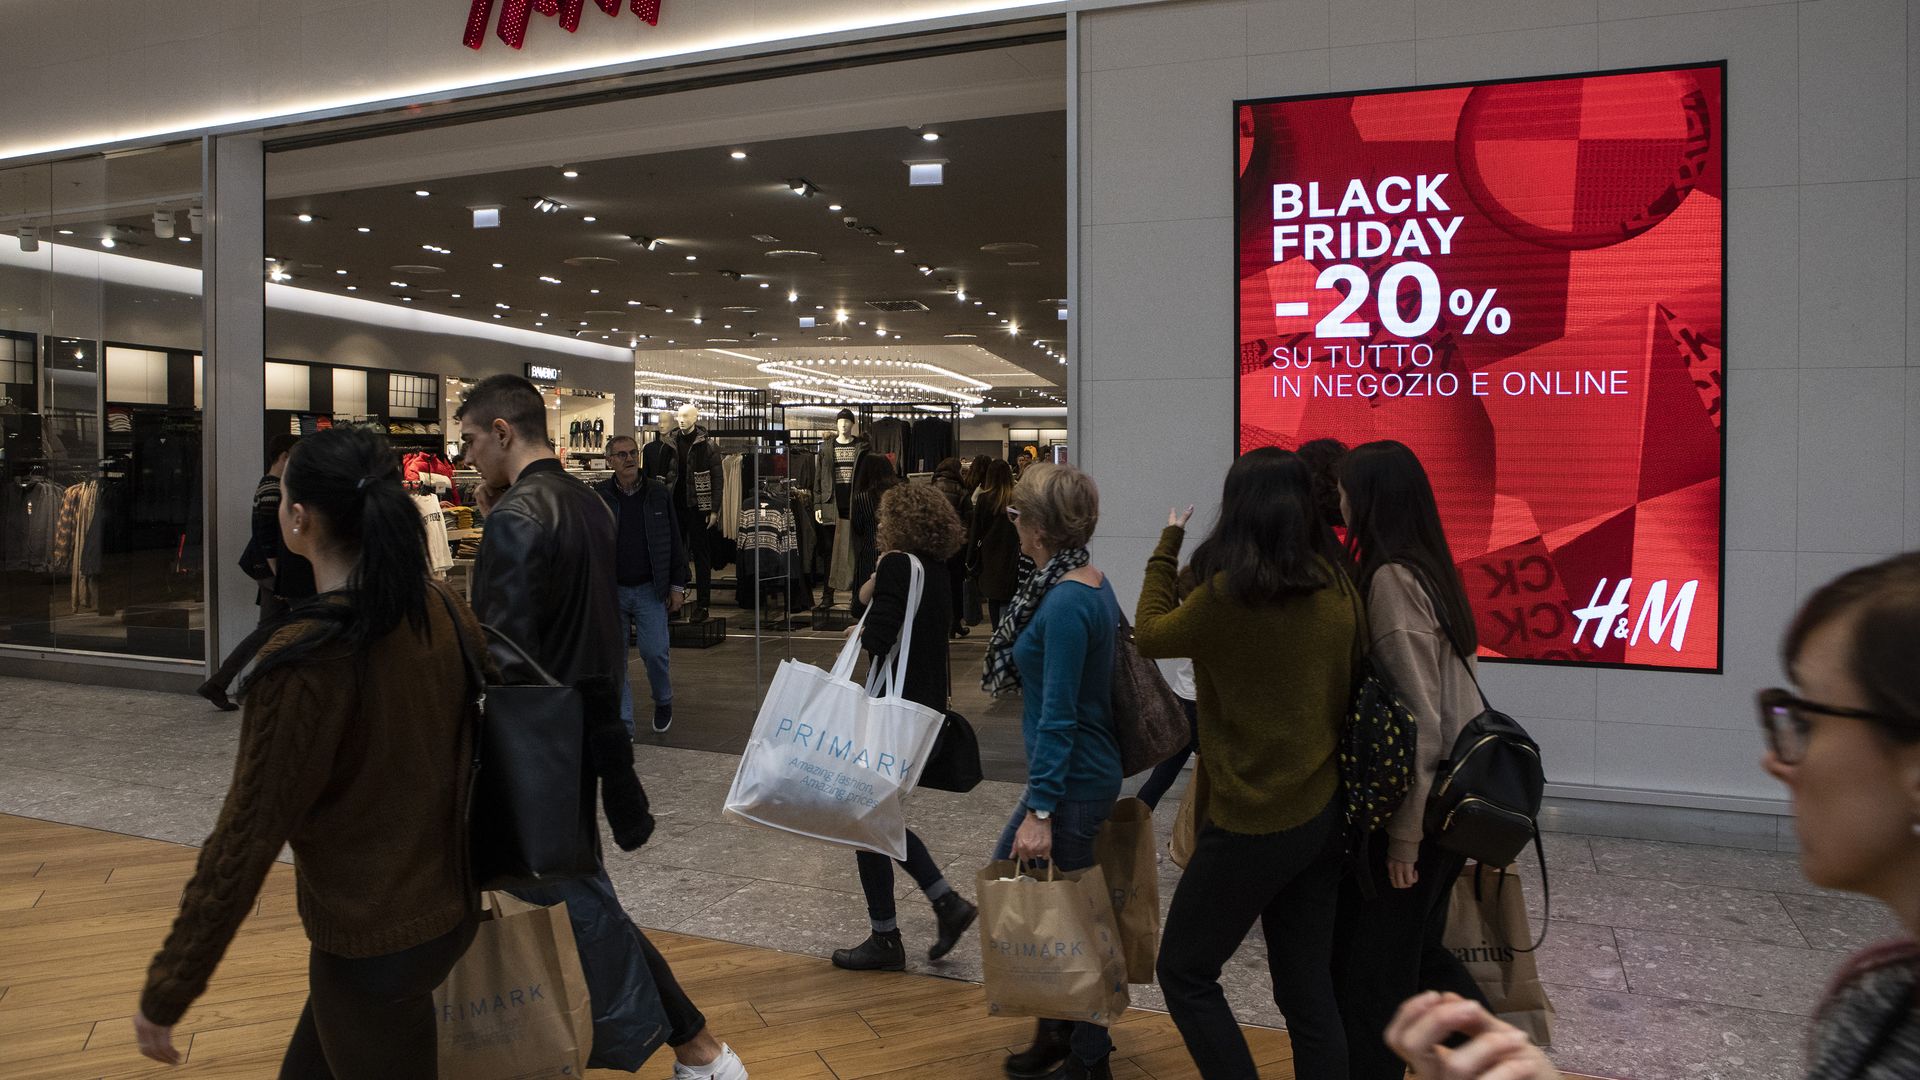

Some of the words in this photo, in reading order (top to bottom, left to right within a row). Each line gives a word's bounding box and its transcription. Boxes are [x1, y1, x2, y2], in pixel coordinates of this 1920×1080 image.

[1272, 173, 1451, 220] BLACK
[1272, 216, 1465, 262] FRIDAY
[1273, 347, 1312, 370] SU
[1323, 343, 1434, 368] TUTTO
[1273, 375, 1301, 398] IN
[1313, 372, 1459, 398] NEGOZIO
[1472, 372, 1490, 396] E
[1502, 370, 1630, 396] ONLINE
[1572, 577, 1699, 653] H&M
[775, 718, 914, 780] PRIMARK
[788, 756, 834, 783] Amazing
[835, 771, 874, 796] fashion,
[800, 774, 846, 801] Amazing
[845, 790, 880, 809] prices
